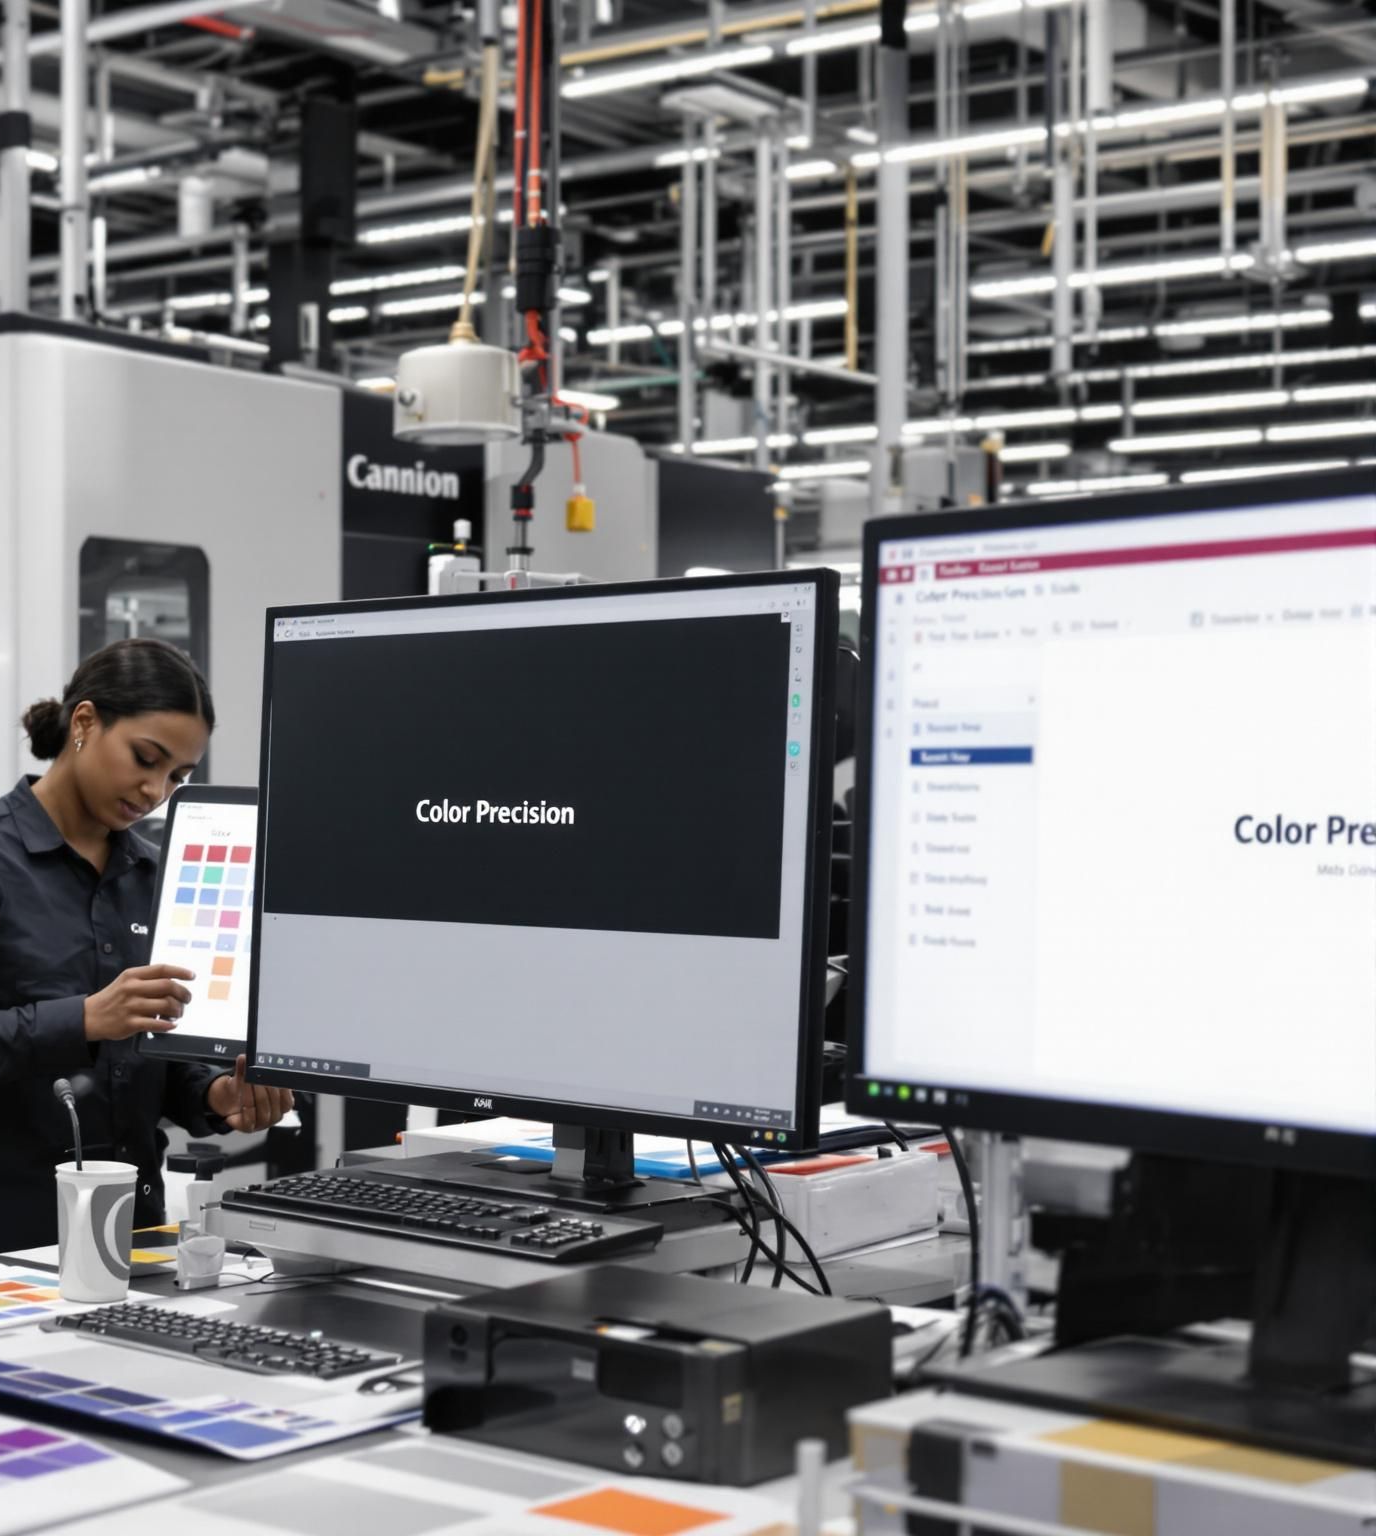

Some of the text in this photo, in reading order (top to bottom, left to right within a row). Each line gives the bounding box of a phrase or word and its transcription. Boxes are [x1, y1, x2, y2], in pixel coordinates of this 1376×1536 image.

[347, 453, 460, 499] Cannion
[416, 798, 575, 825] Color Precision
[1234, 813, 1376, 846] Color Pre
